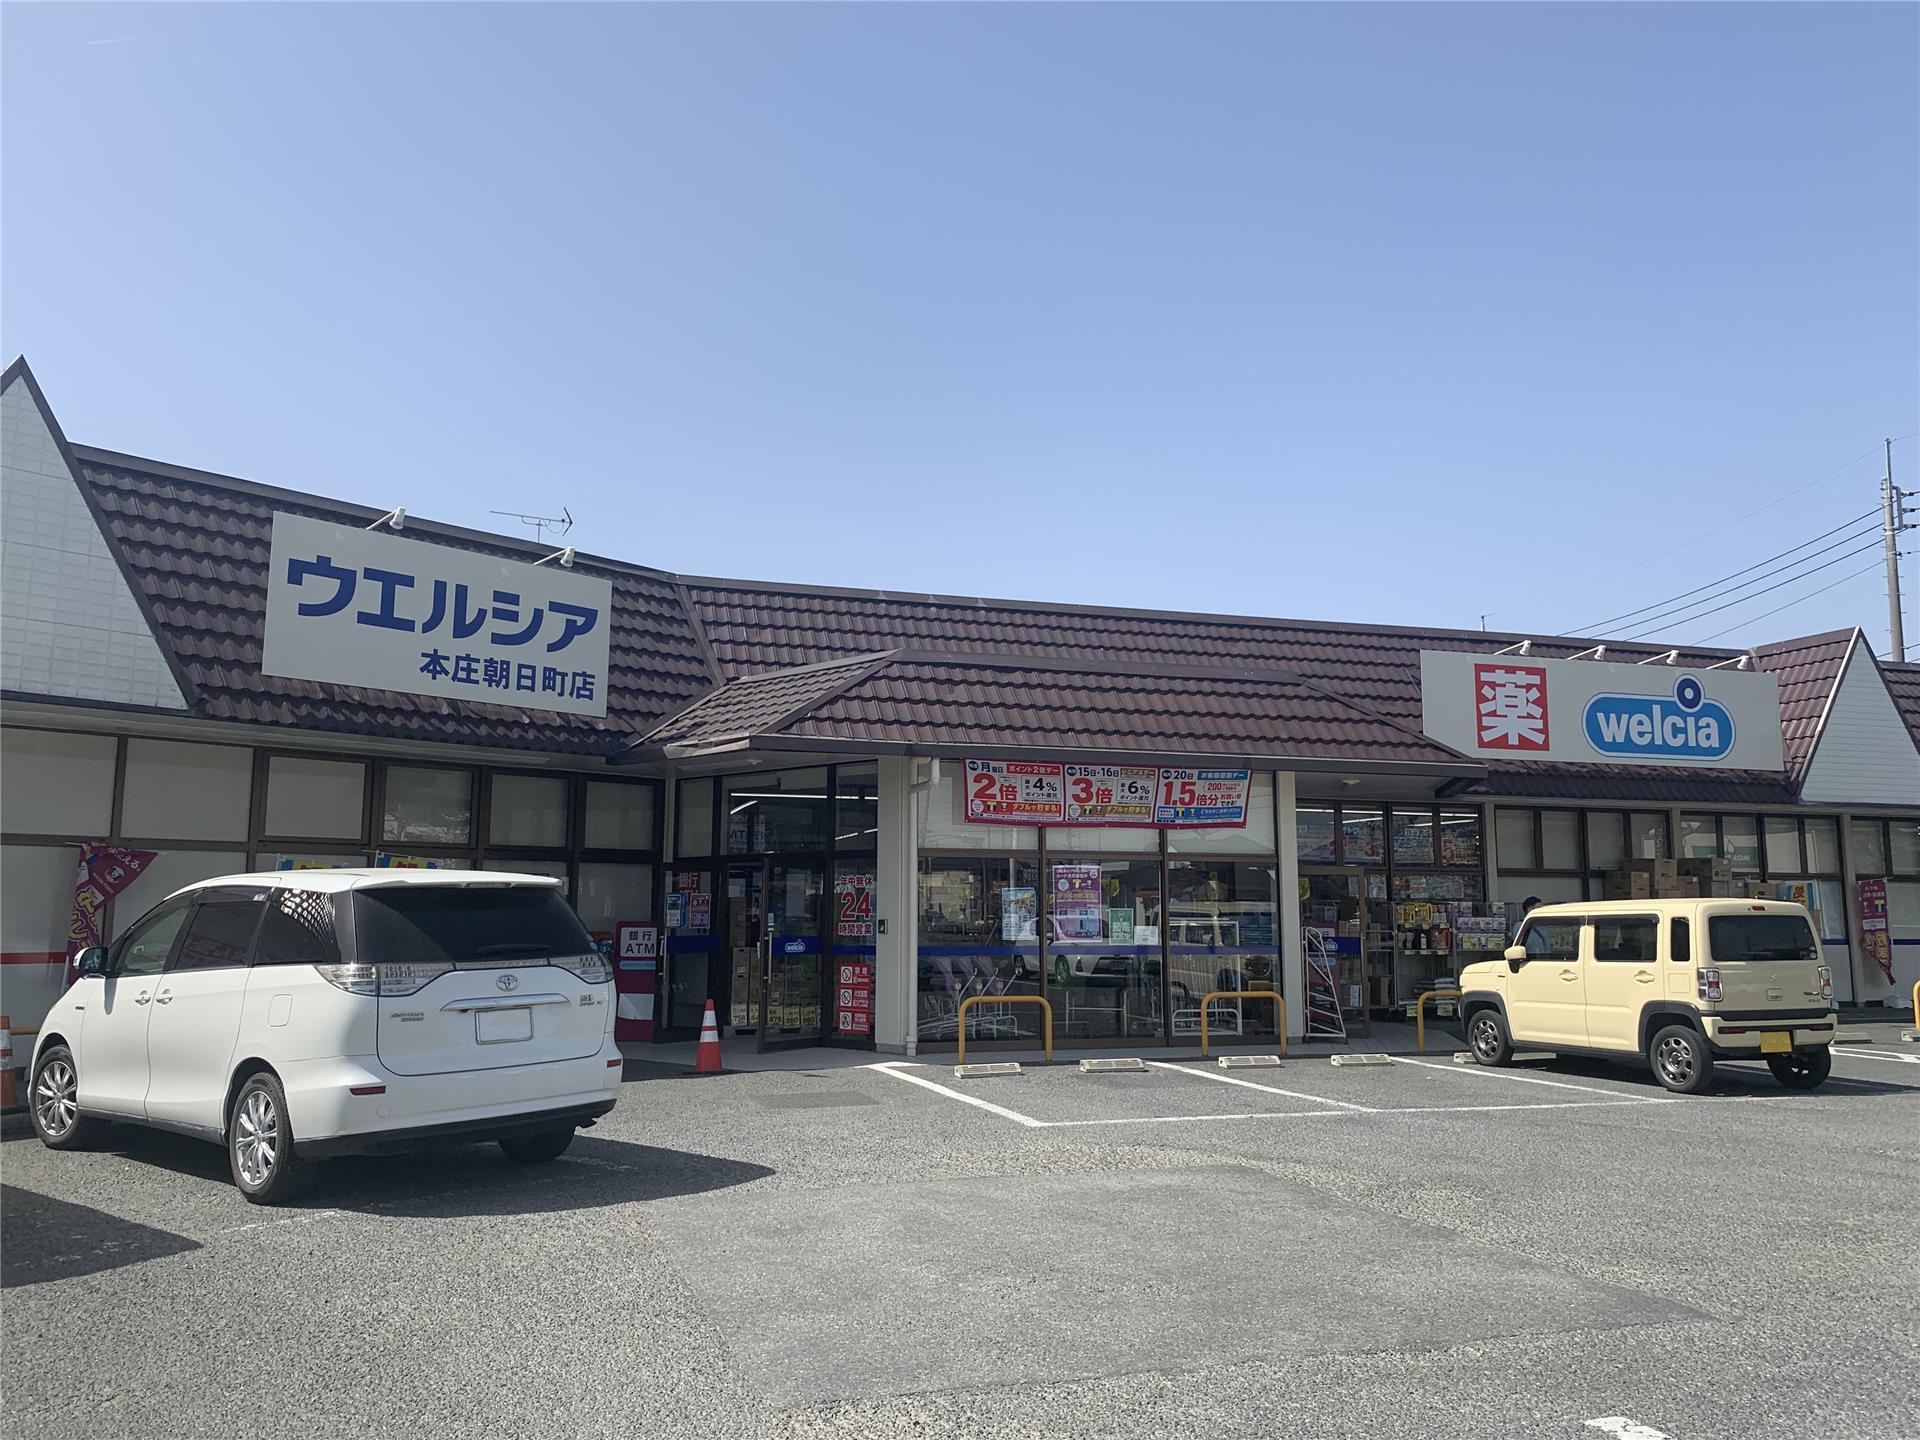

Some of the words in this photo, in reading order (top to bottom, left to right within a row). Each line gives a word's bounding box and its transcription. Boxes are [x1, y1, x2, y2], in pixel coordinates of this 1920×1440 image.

[287, 555, 599, 653] ウエルシア
[419, 648, 596, 701] 本庄朝日町店
[1479, 669, 1545, 746] 薬
[1596, 676, 1719, 748] welcia
[1173, 771, 1194, 780] 20日
[840, 875, 873, 887] 年中無休
[840, 891, 872, 920] 24
[628, 930, 652, 941] 銀行
[838, 923, 874, 936] 時間営業
[625, 943, 655, 954] ATM
